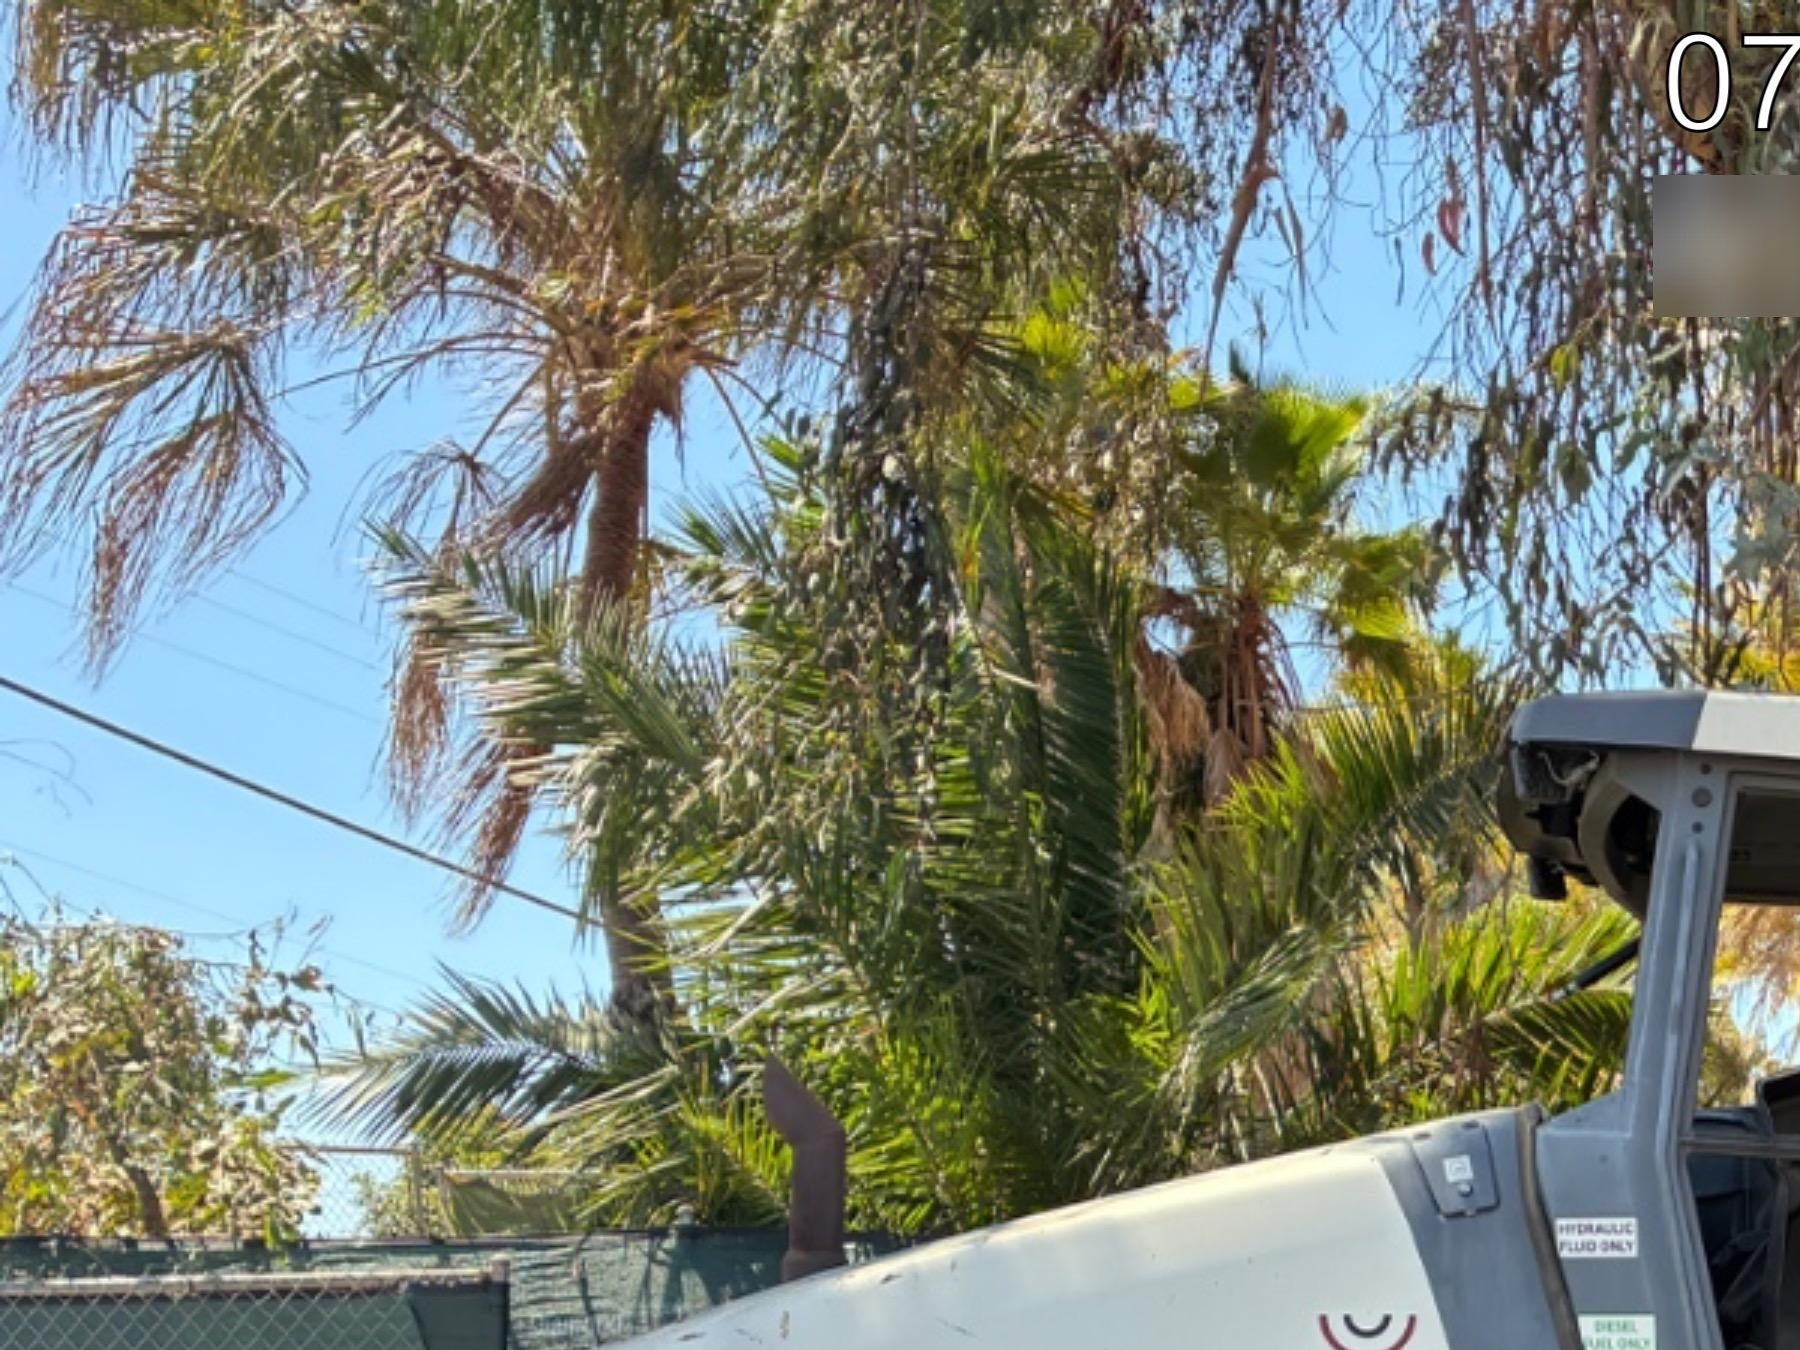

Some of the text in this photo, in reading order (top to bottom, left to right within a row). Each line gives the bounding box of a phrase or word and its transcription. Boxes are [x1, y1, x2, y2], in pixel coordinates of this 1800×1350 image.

[1559, 1223, 1634, 1235] HYDRAULIC
[1559, 1240, 1634, 1252] FLUID ONLY
